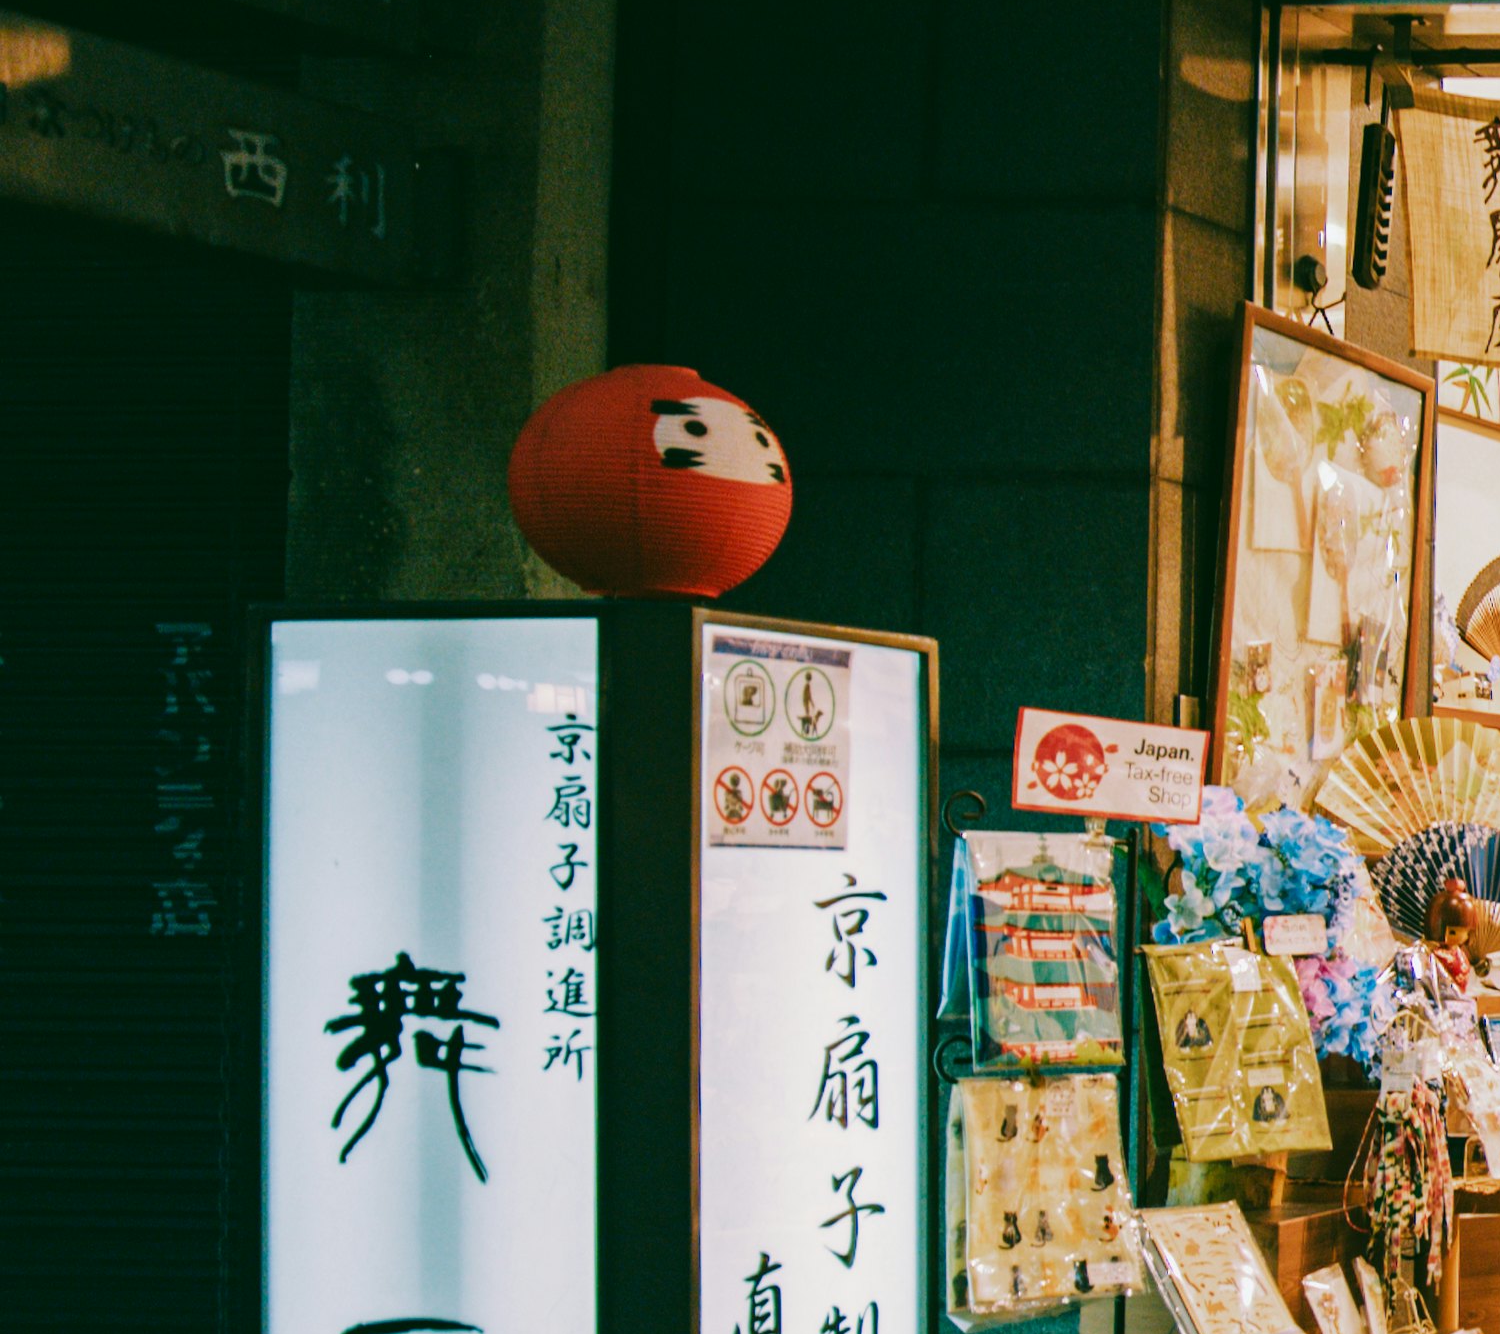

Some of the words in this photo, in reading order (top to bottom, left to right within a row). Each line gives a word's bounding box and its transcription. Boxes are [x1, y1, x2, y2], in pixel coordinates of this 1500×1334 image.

[218, 125, 388, 243] 西利
[1133, 738, 1195, 763] Japan.
[1124, 760, 1194, 786] Tax-free
[1147, 785, 1192, 811] Shop
[541, 712, 598, 1083] 京扇子調進所
